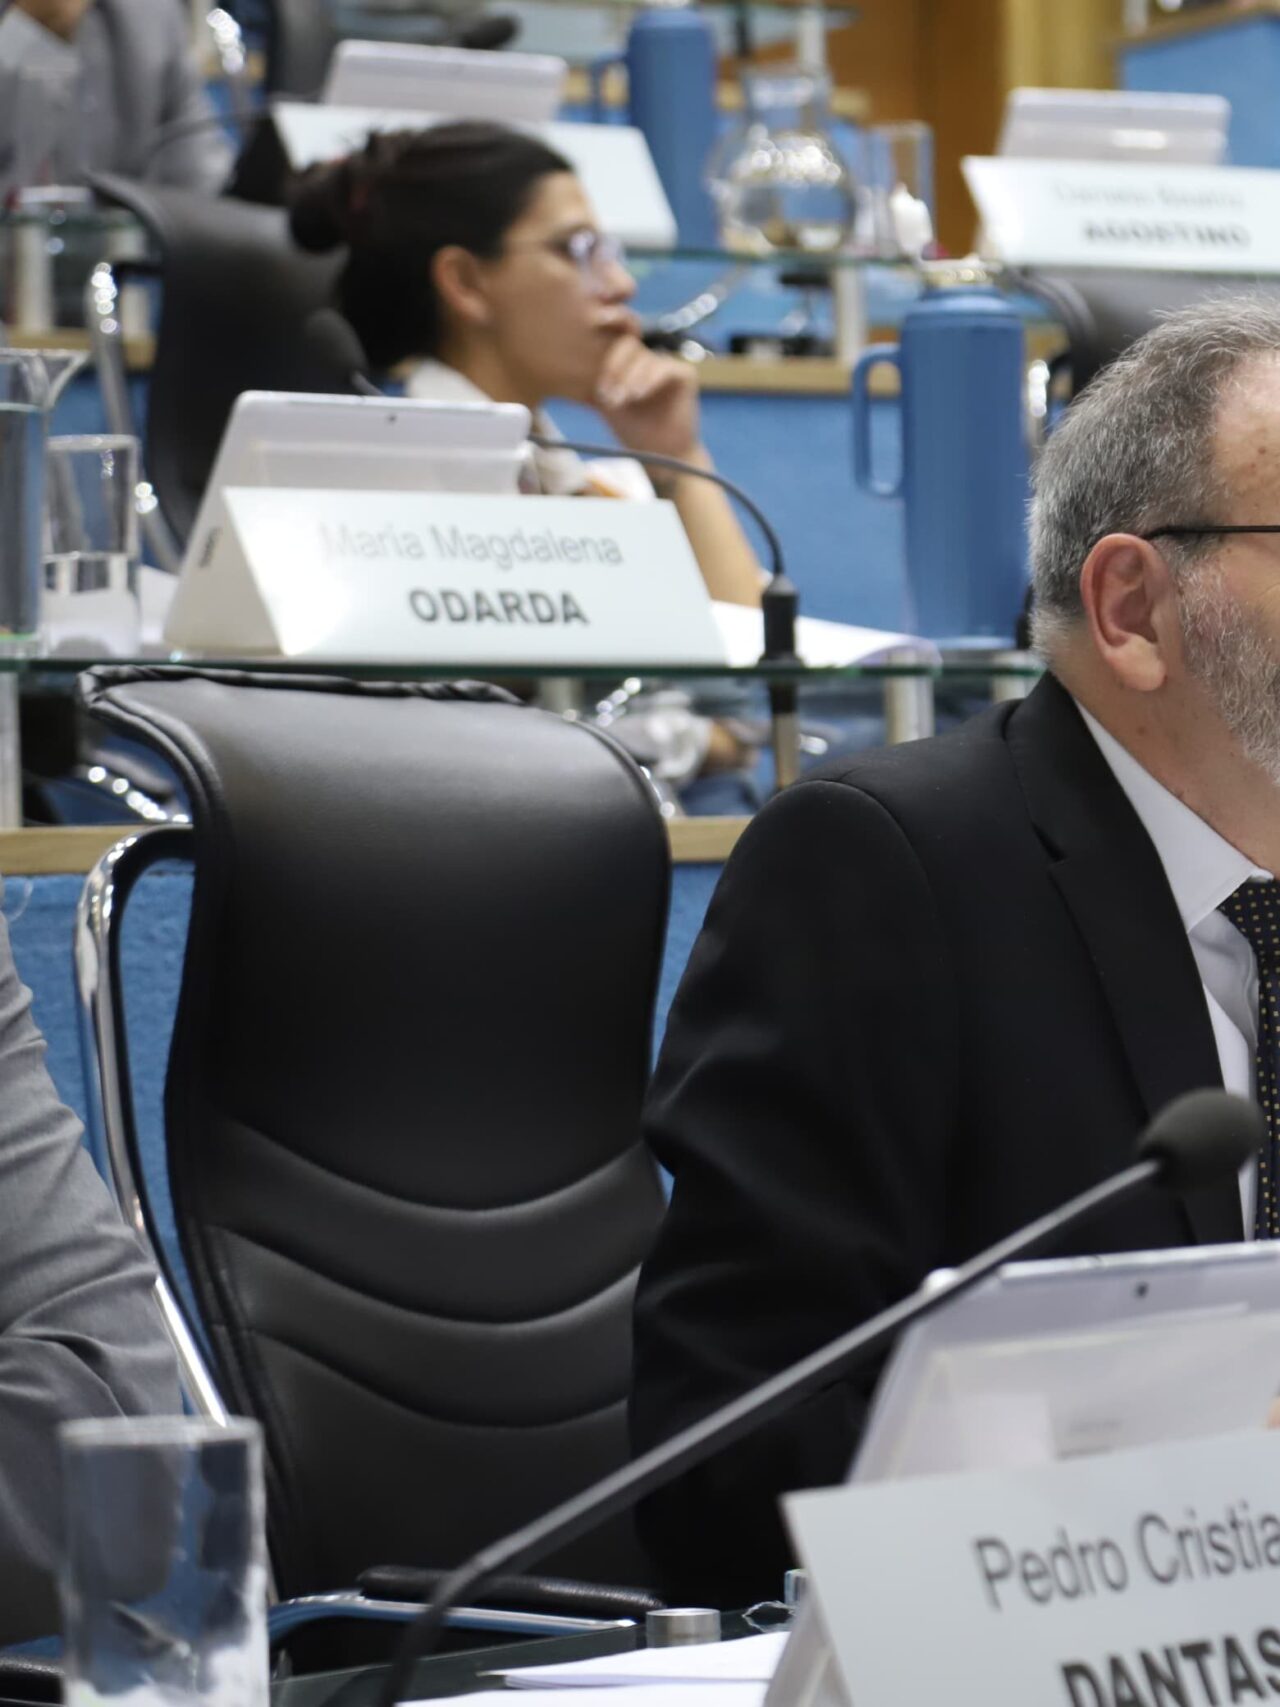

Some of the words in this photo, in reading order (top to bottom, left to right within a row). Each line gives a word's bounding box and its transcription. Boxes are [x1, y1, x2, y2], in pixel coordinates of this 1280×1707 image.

[429, 525, 623, 570] Magdalena
[408, 589, 589, 624] ODARDA
[974, 1527, 1129, 1611] Pedro
